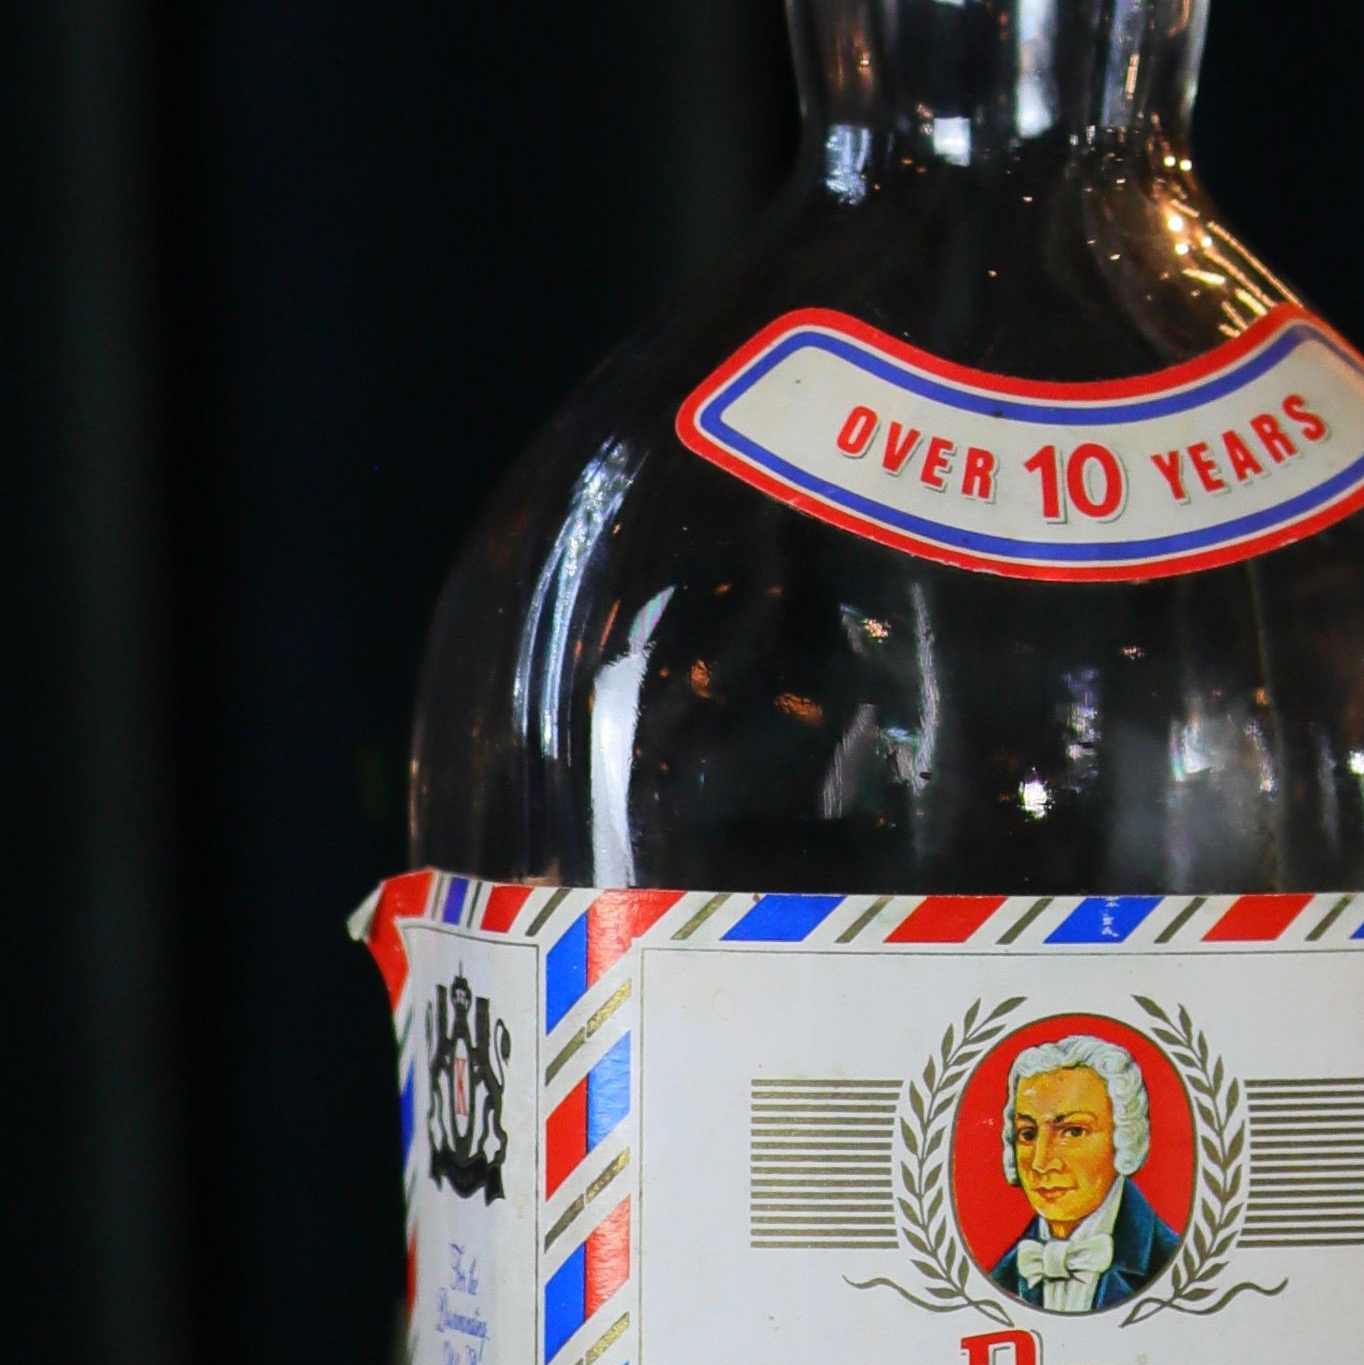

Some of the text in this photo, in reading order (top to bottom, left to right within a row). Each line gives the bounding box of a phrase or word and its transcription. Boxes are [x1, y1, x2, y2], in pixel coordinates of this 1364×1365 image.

[836, 393, 1330, 523] OVER 10 YEARS
